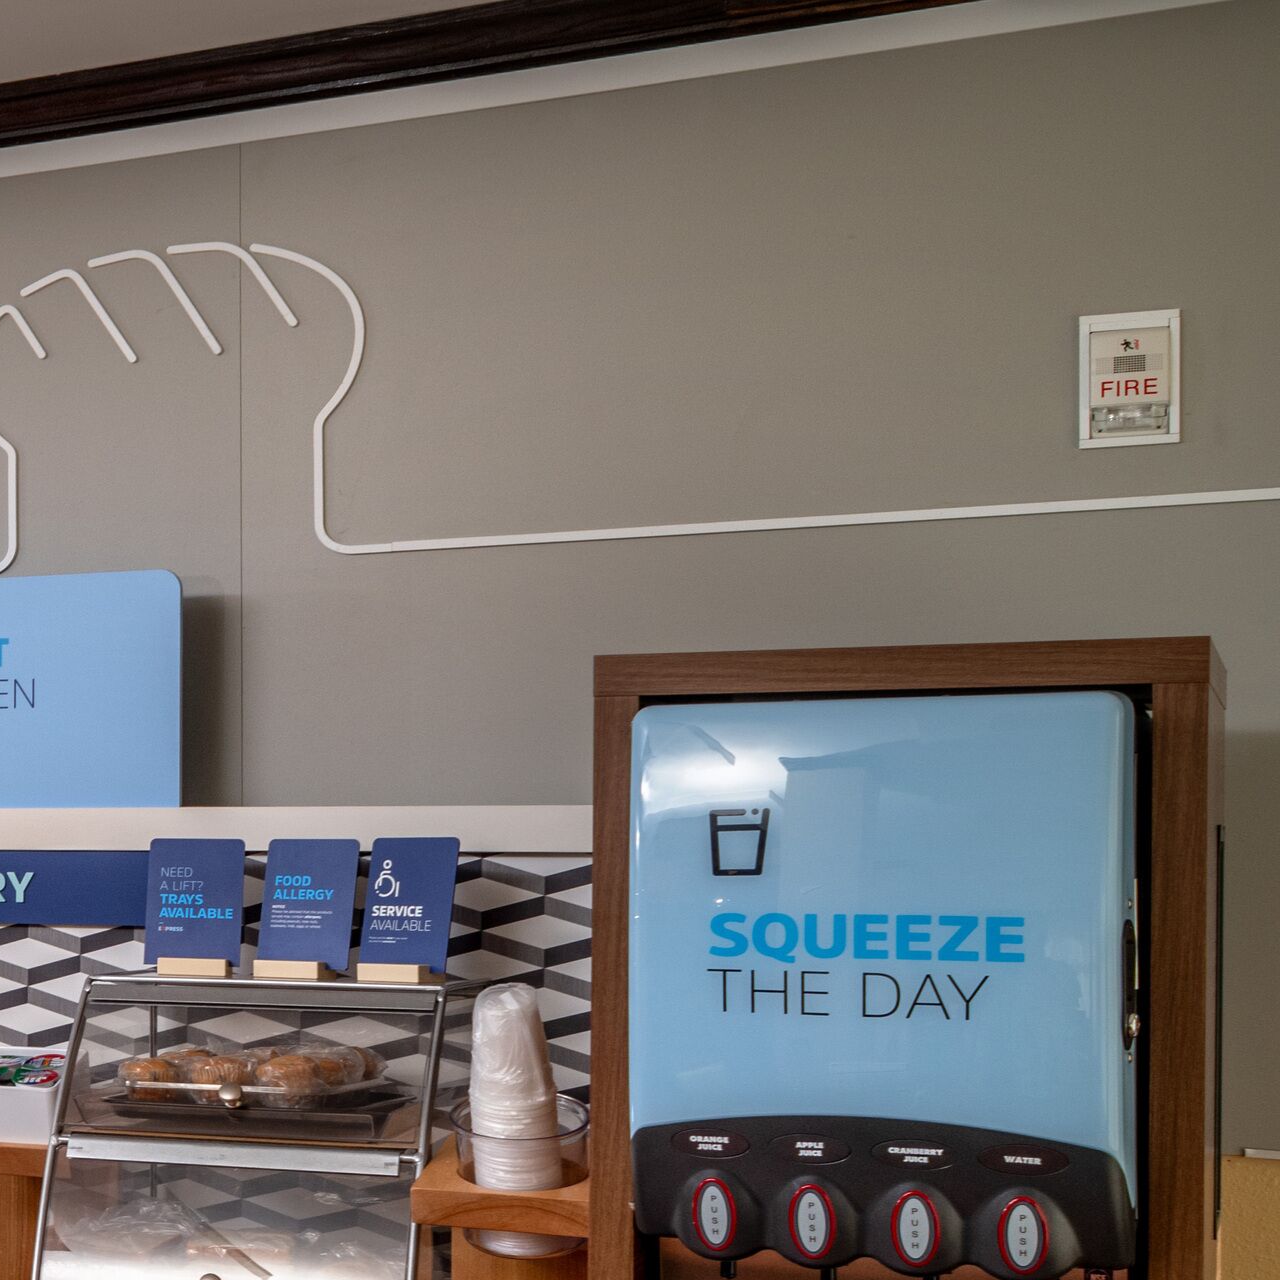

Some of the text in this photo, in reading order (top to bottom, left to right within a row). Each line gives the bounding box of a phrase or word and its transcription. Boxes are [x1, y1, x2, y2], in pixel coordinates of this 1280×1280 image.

[1101, 377, 1158, 398] FIRE
[160, 867, 193, 878] NEED
[159, 880, 204, 891] A LIFT?
[274, 875, 311, 887] FOOD
[159, 894, 204, 905] TRAYS
[273, 888, 334, 901] ALLERGY
[159, 907, 233, 920] AVAILABLE
[371, 905, 423, 917] SERVICE
[369, 919, 432, 932] AVAILABLE
[708, 912, 1025, 963] SQUEEZE
[707, 968, 989, 1020] THE DAY
[689, 1135, 730, 1144] ORANGE
[795, 1141, 824, 1149] APPLE
[697, 1143, 723, 1151] JUICE
[798, 1149, 823, 1157] JUICE
[887, 1146, 944, 1156] CRANBERRY
[902, 1155, 929, 1164] JUICE
[1003, 1155, 1042, 1166] WATER
[710, 1195, 719, 1235] PUSH
[807, 1202, 817, 1243] PUSH
[911, 1207, 920, 1249] PUSH
[1018, 1214, 1028, 1257] PUSH
